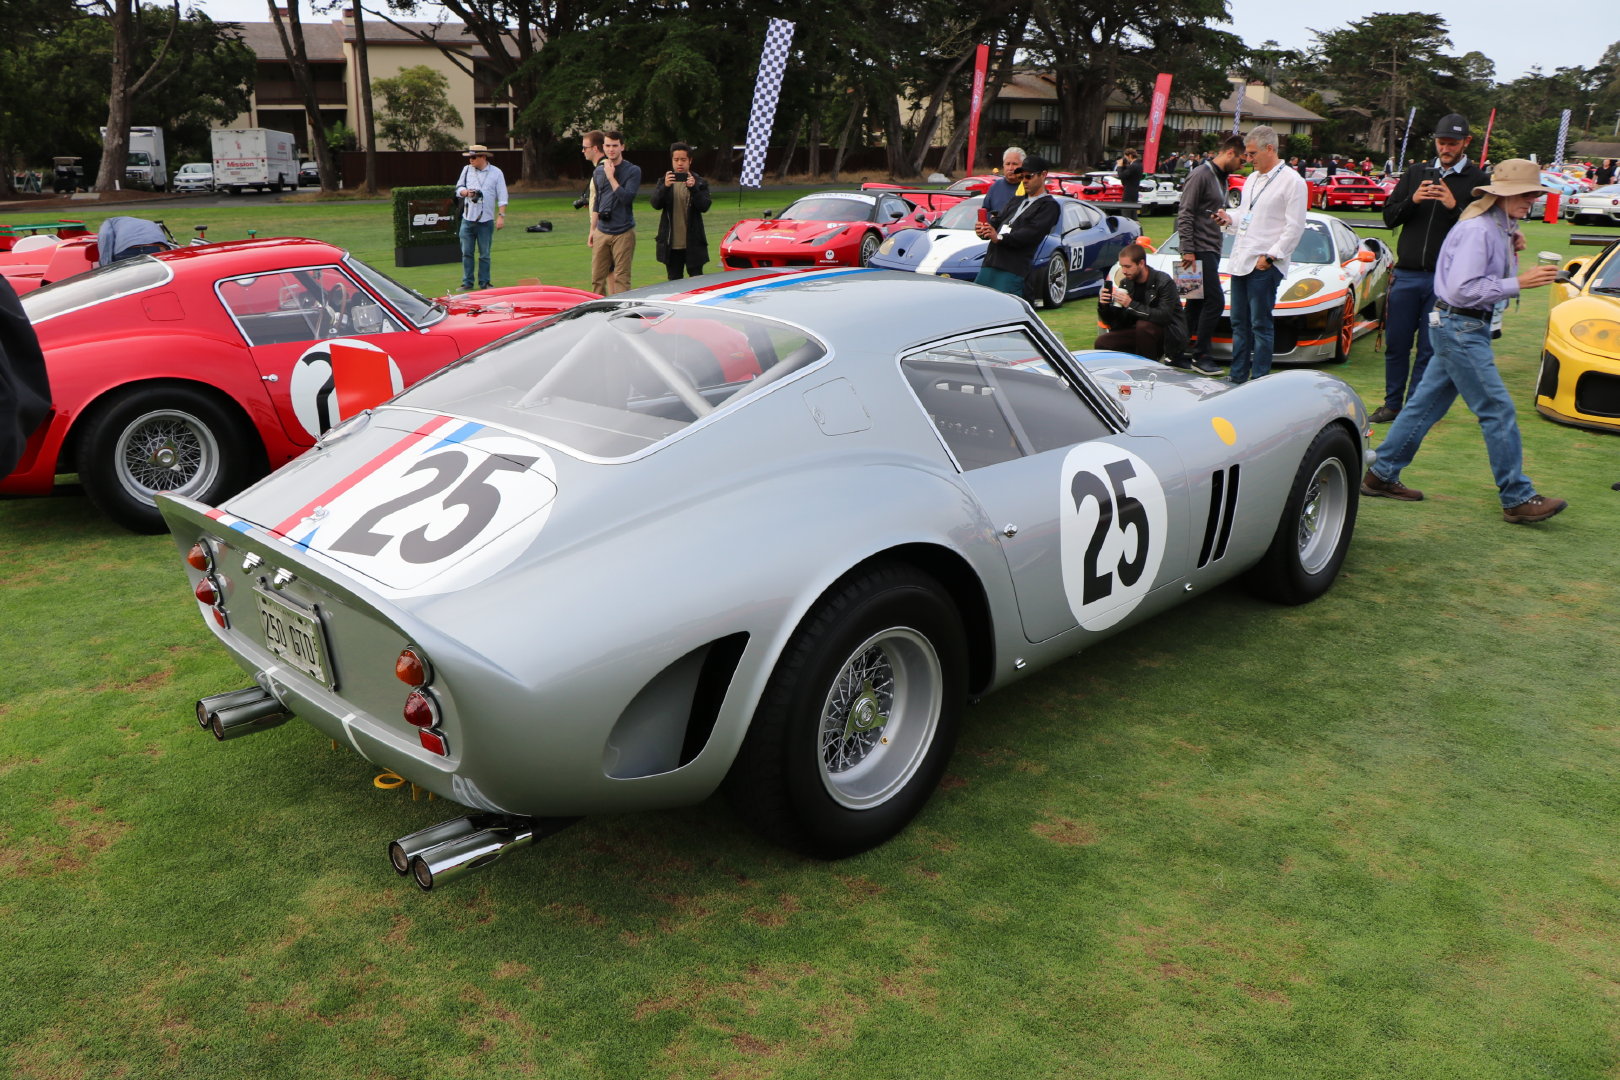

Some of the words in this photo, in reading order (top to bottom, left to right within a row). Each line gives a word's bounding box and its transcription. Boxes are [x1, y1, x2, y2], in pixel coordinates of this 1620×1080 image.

[1071, 247, 1083, 269] 26
[328, 450, 541, 565] 25
[1070, 458, 1150, 606] 25
[261, 610, 287, 648] 250
[289, 625, 316, 665] GTO
